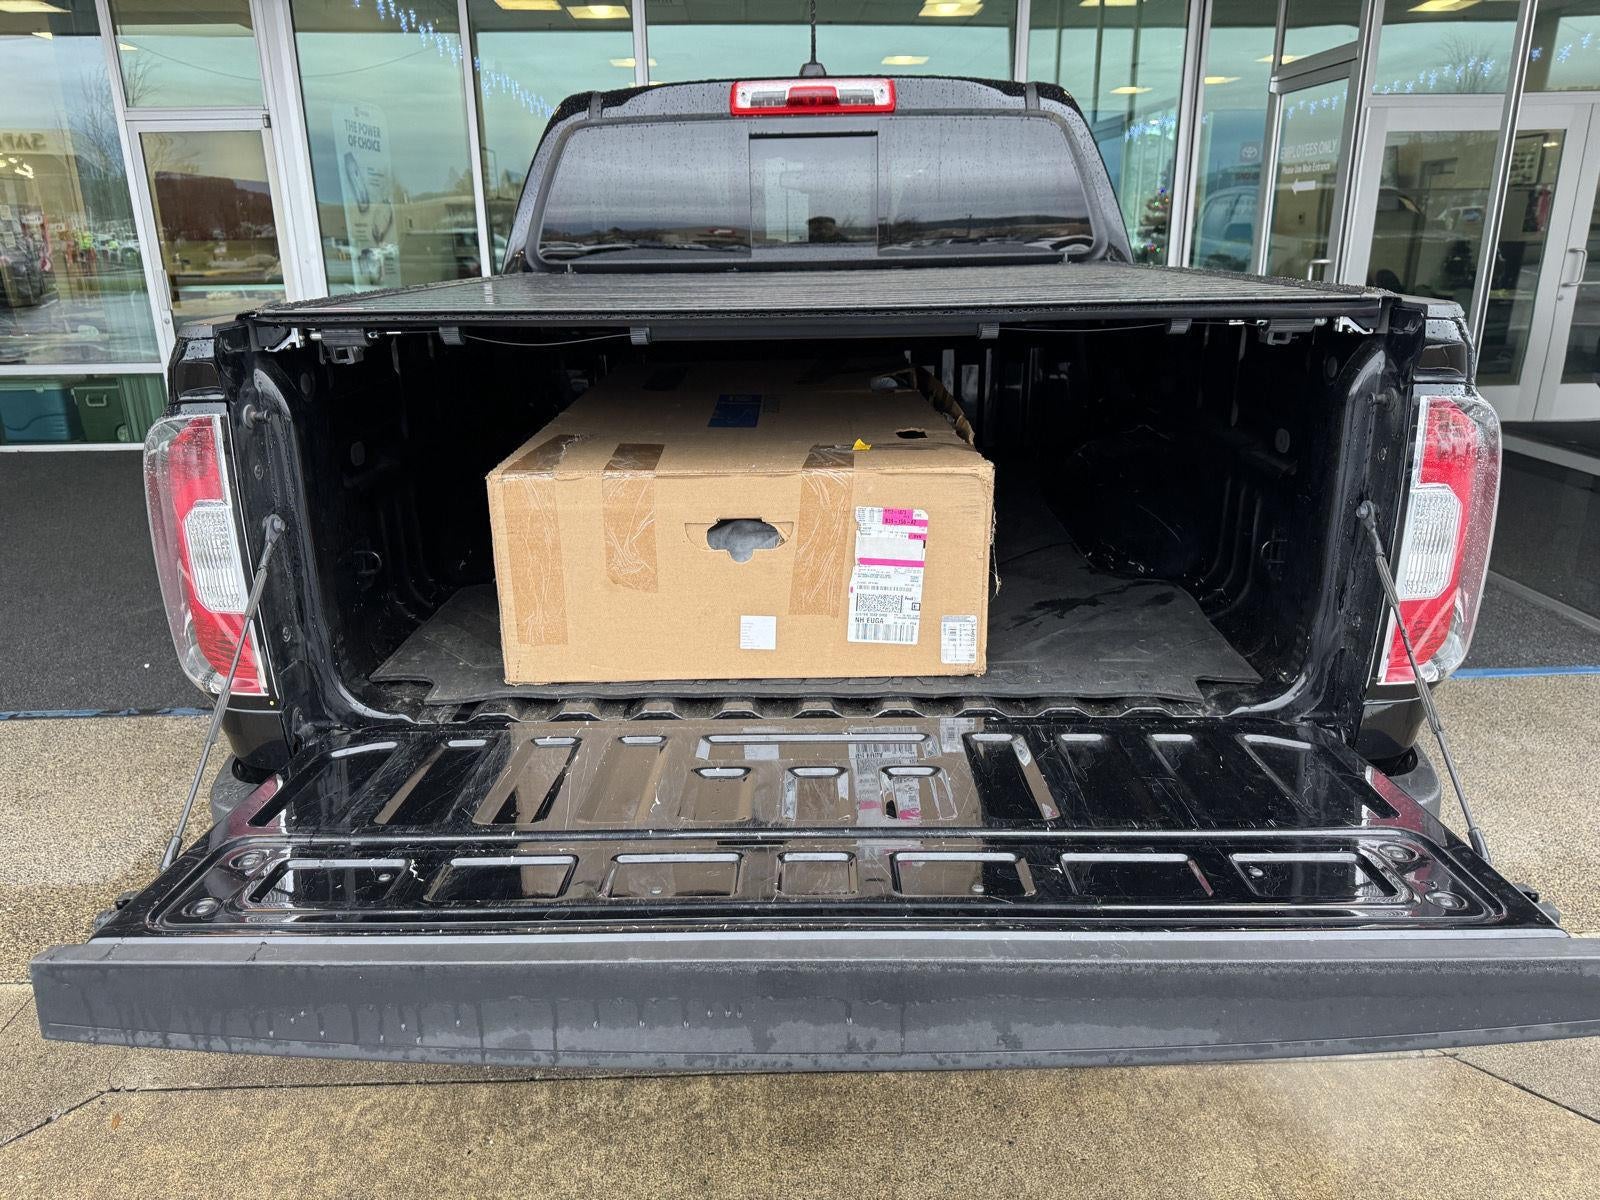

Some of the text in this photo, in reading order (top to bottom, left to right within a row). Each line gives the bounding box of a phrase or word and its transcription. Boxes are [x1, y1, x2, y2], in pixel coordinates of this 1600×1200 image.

[344, 119, 381, 138] THE POWER
[348, 134, 381, 152] OF CHOICE
[1280, 143, 1318, 160] EMPLOYEES
[855, 616, 865, 624] NH
